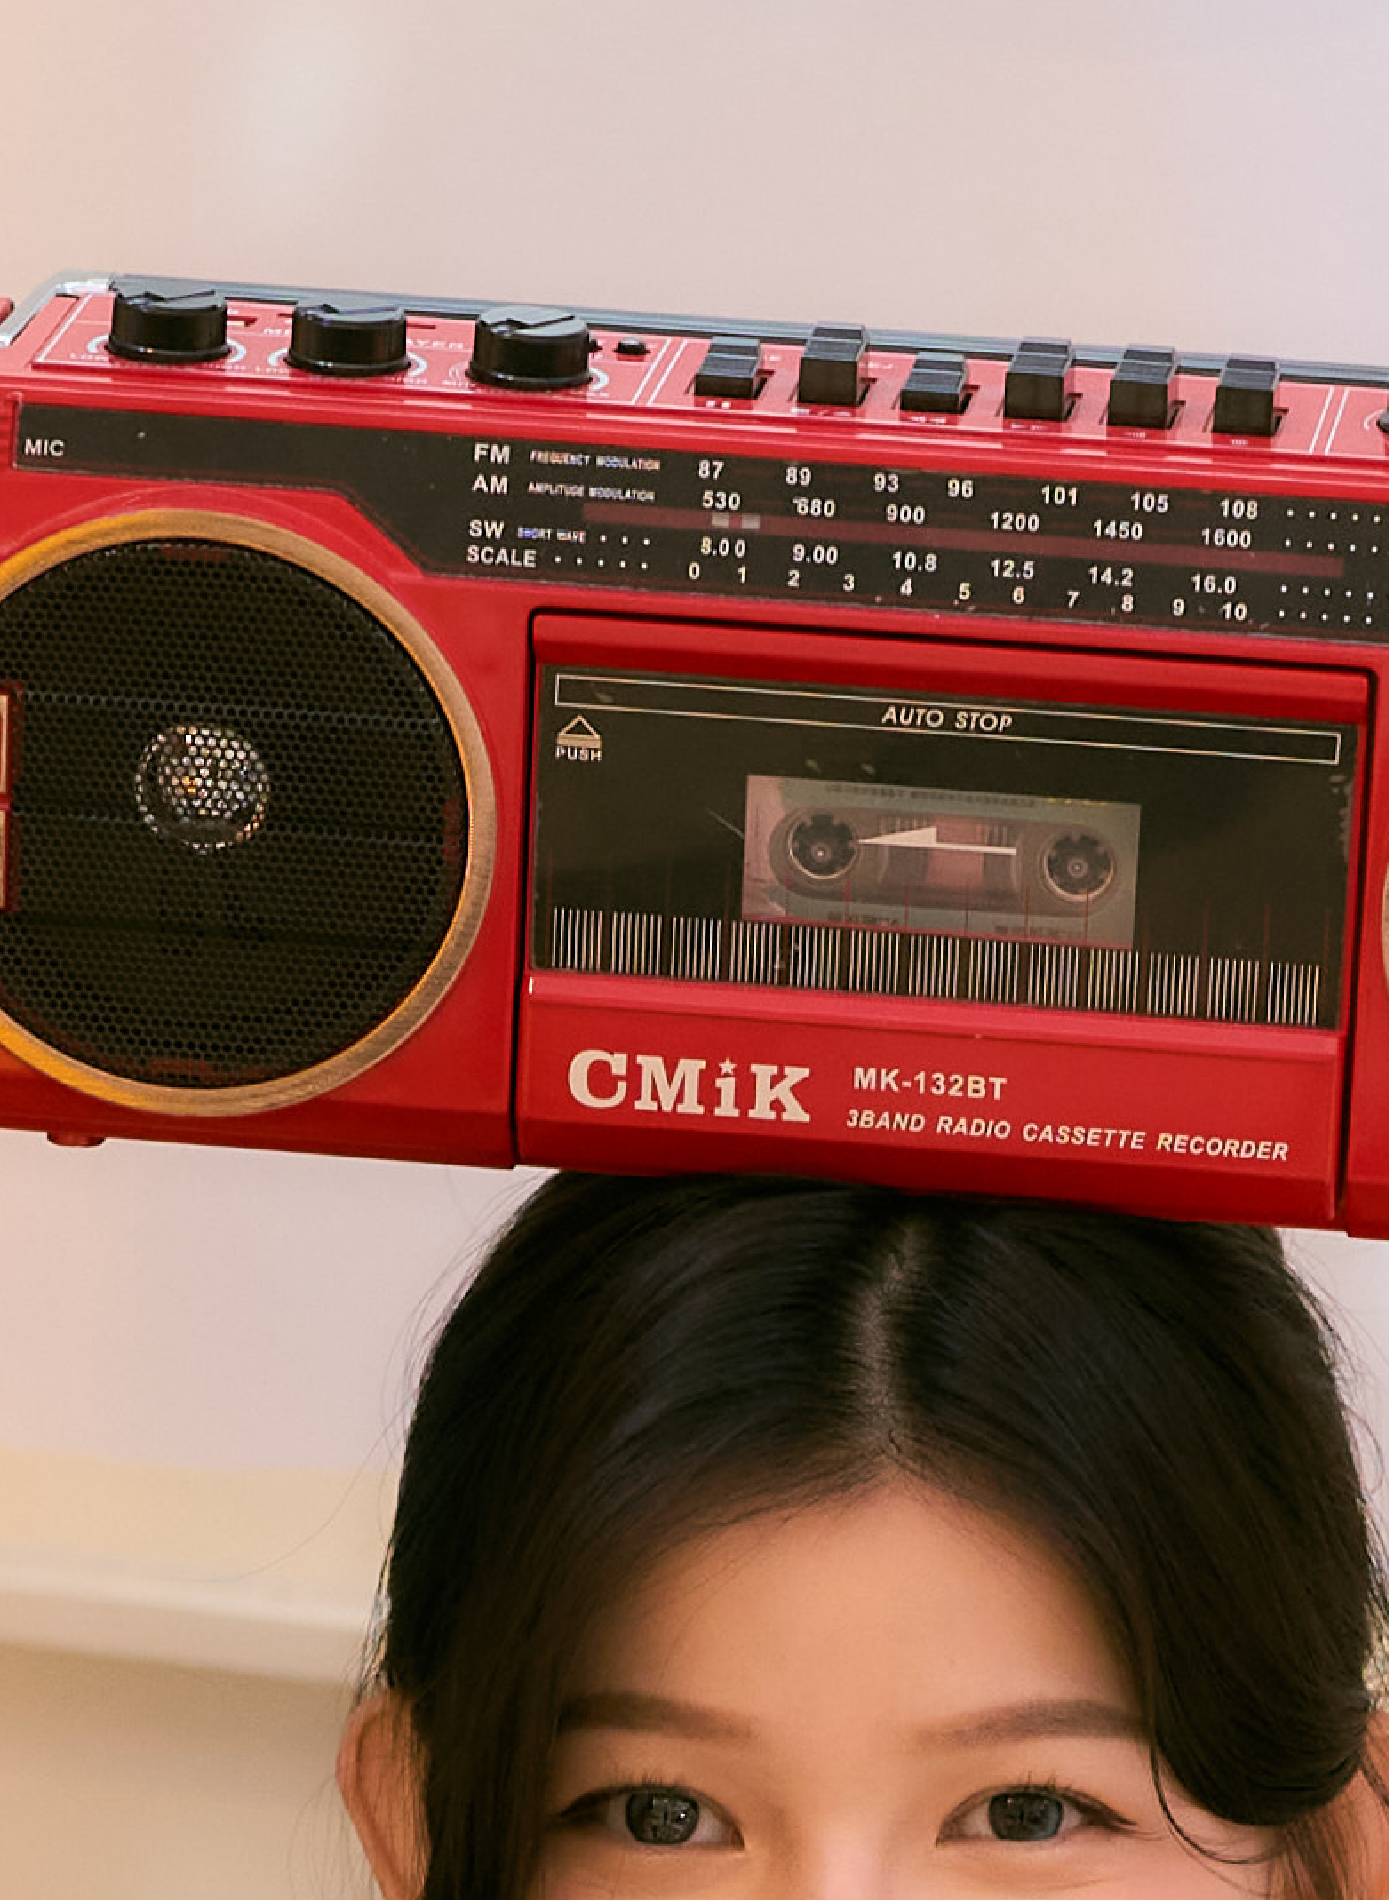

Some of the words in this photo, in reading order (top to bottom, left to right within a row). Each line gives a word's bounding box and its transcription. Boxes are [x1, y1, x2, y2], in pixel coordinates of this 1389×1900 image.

[23, 438, 66, 457] MIC
[472, 474, 509, 495] AM
[702, 490, 741, 511] 530
[795, 497, 836, 518] 680
[886, 503, 926, 525] 900
[990, 511, 1041, 533] 1200
[1093, 518, 1143, 541] 1450
[1201, 527, 1252, 549] 1600
[473, 442, 510, 465] FM
[698, 459, 724, 480] 87
[785, 466, 811, 487] 89
[873, 472, 899, 493] 93
[947, 478, 974, 498] 96
[1041, 485, 1078, 507] 101
[1130, 491, 1169, 513] 105
[1219, 497, 1259, 520] 108
[466, 545, 538, 568] SCALE
[688, 561, 701, 581] 0
[737, 564, 747, 584] 1
[787, 568, 801, 589] 2
[842, 573, 855, 593] 3
[899, 576, 913, 597] 4
[958, 581, 971, 601] 5
[1012, 585, 1026, 605] 6
[1067, 589, 1080, 609] 7
[1121, 593, 1134, 613] 8
[1172, 598, 1186, 617] 9
[1219, 601, 1249, 622] 10
[469, 519, 505, 539] SW
[792, 543, 839, 566] 9.00
[892, 550, 938, 573] 10.8
[991, 558, 1035, 580] 12.5
[1088, 565, 1134, 588] 14.2
[1190, 573, 1238, 595] 16.0
[881, 705, 945, 730] AUTO
[954, 710, 1013, 733] STOP
[555, 745, 603, 762] PUSH
[567, 1048, 811, 1123] CMiK
[852, 1066, 1008, 1100] MK-132BT
[845, 1108, 926, 1133] 3BAND
[935, 1115, 1012, 1140] RADIO
[1021, 1122, 1146, 1151] CASSETTE
[1155, 1132, 1289, 1162] RECORDER
